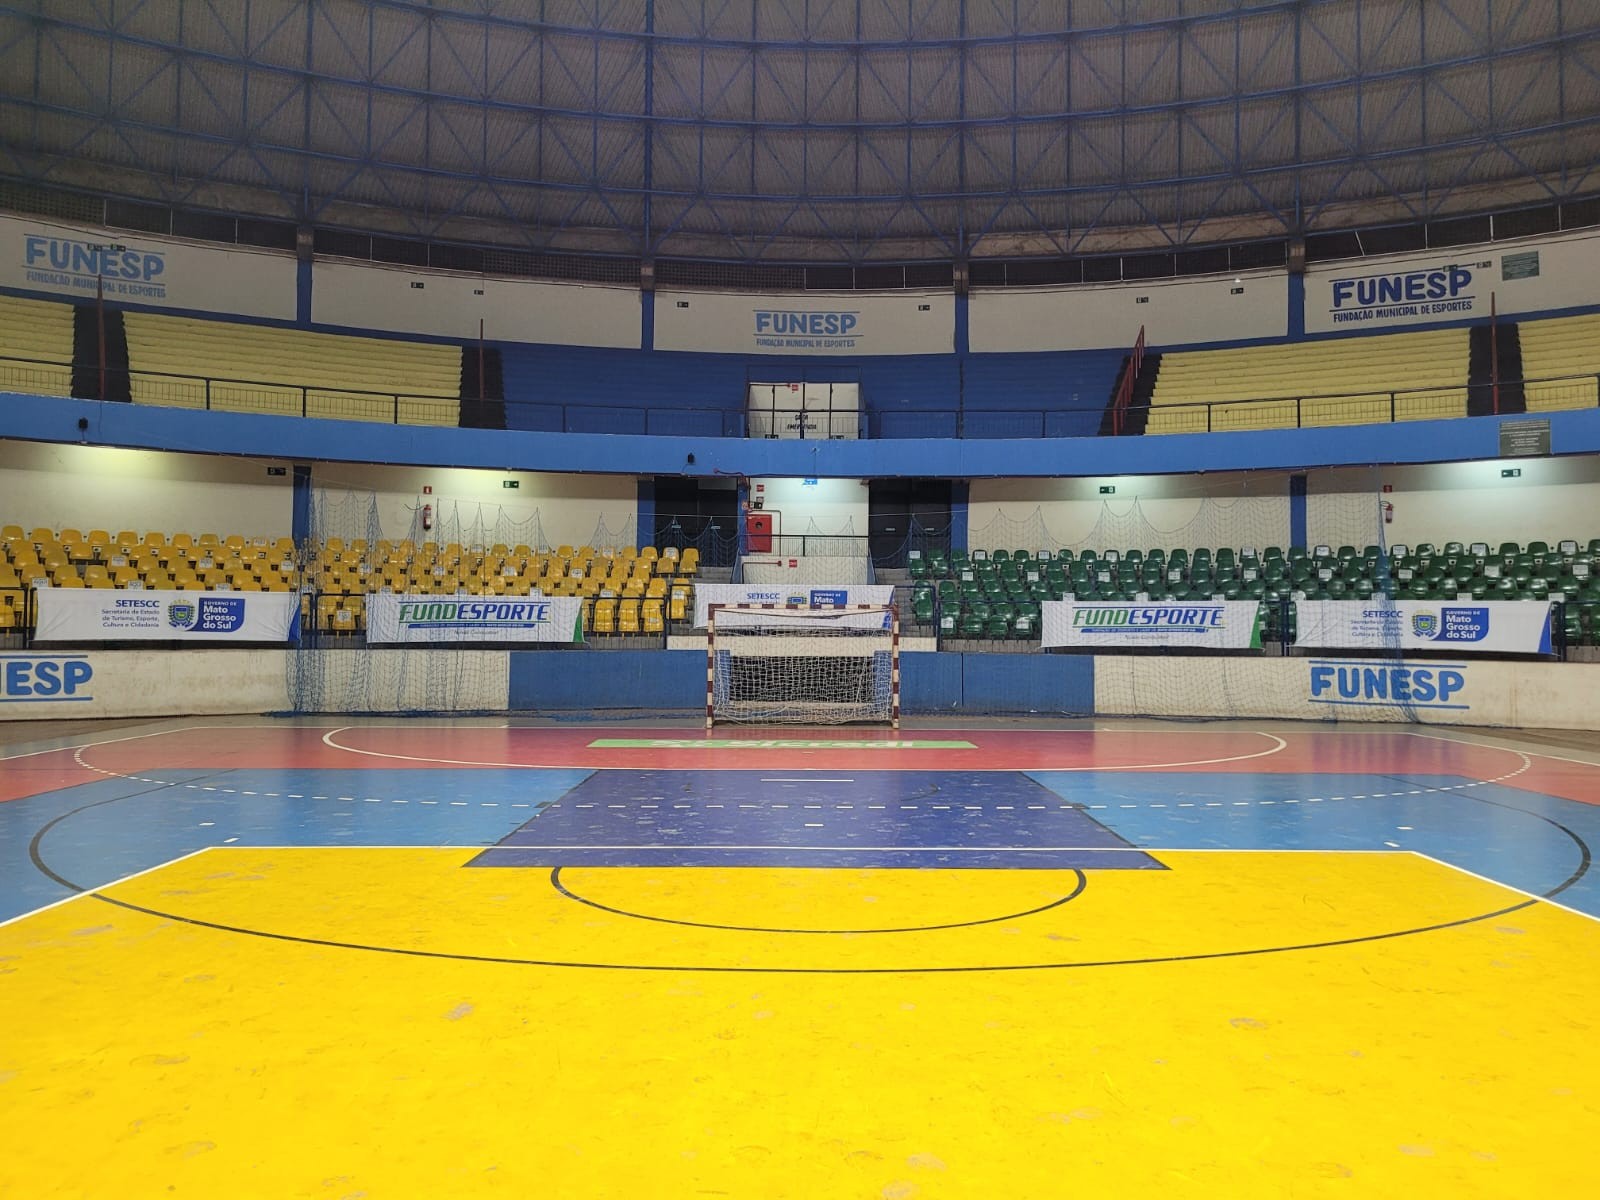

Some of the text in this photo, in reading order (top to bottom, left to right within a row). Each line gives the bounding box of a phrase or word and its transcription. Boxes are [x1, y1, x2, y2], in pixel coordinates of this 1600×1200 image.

[26, 237, 165, 282] FUNESP
[1333, 269, 1472, 308] FUNESP
[1333, 300, 1473, 323] FUNDAÇÃO MUNICIPAL DE ESPORTES
[756, 312, 857, 335] FUNESP
[747, 592, 780, 600] SETESCC
[814, 596, 834, 604] Mato
[115, 599, 160, 608] SETESCC
[203, 605, 228, 613] Mato
[399, 603, 549, 620] FUNDESPORTE
[203, 613, 237, 621] Grosso
[1072, 609, 1224, 625] FUNDESPORTE
[1362, 610, 1404, 618] SETESCC
[1446, 614, 1472, 623] Mato
[202, 621, 232, 629] do Sul
[1446, 622, 1480, 631] Grosso
[1446, 630, 1476, 639] do Sul
[0, 661, 93, 695] ESP
[1310, 666, 1465, 701] FUNESP
